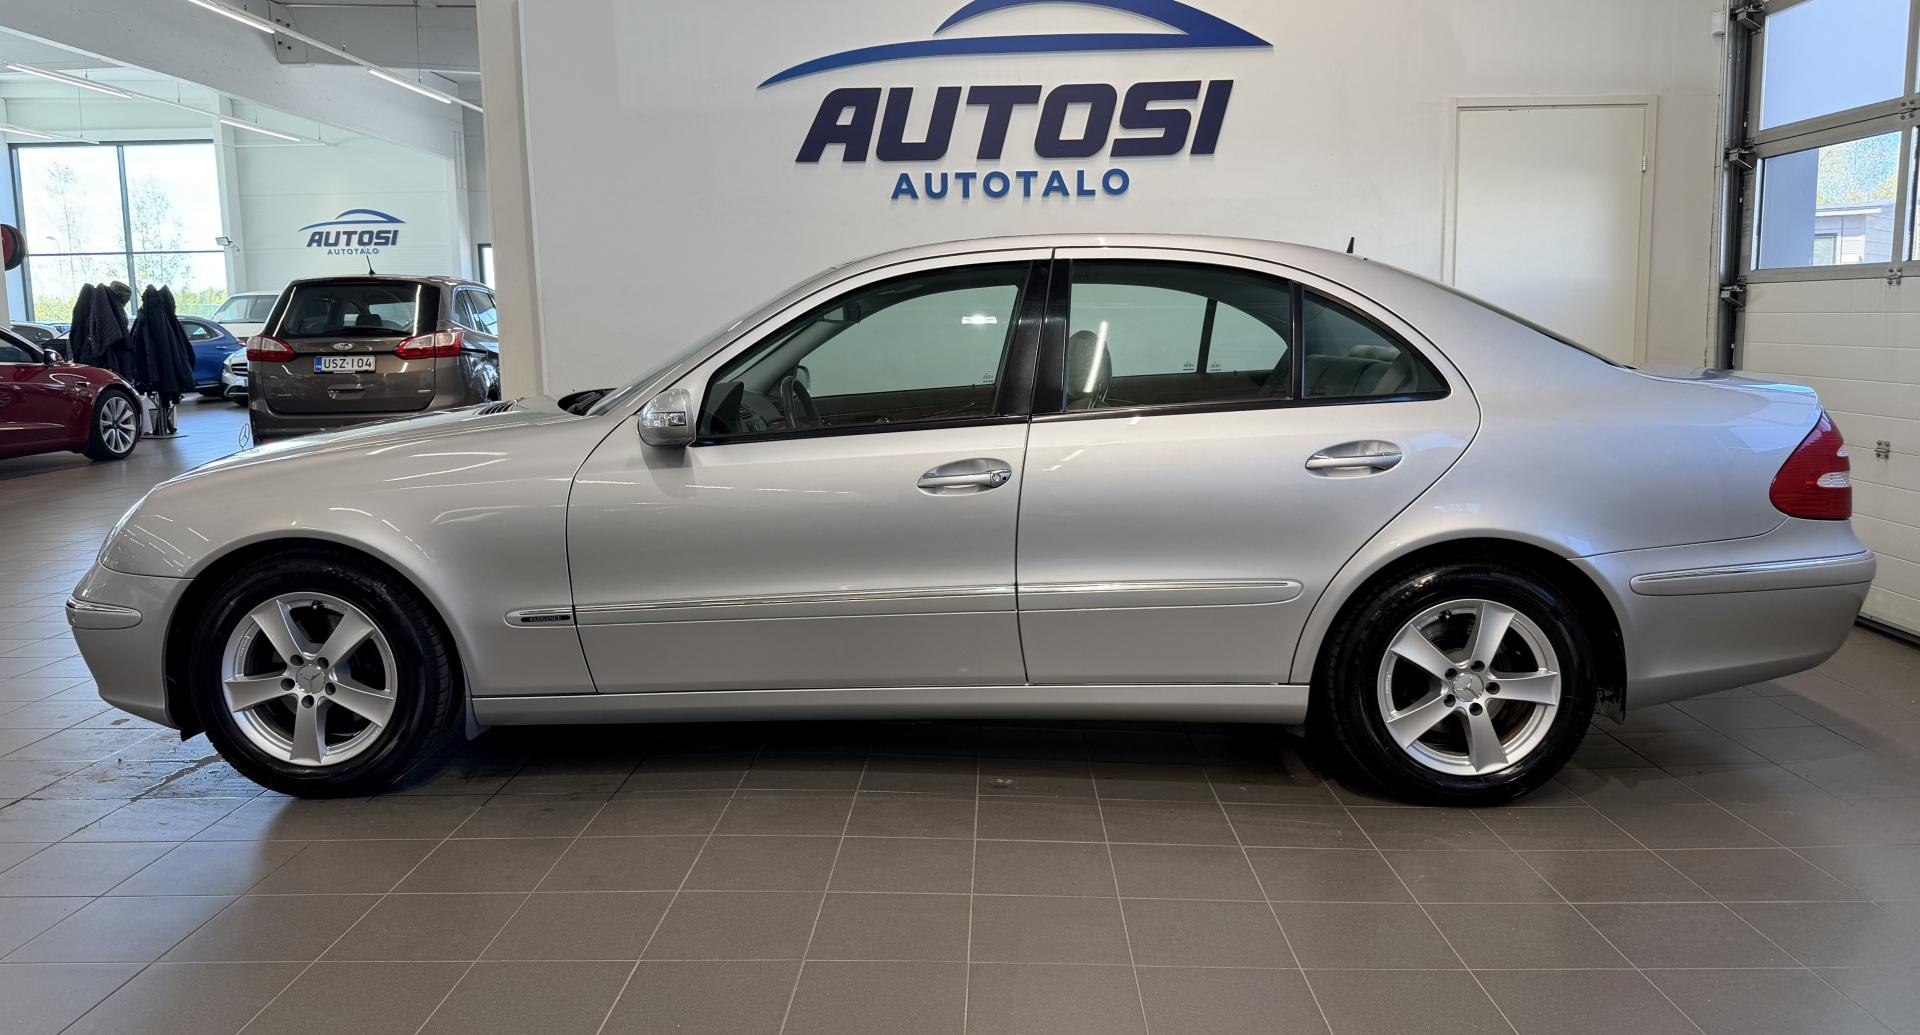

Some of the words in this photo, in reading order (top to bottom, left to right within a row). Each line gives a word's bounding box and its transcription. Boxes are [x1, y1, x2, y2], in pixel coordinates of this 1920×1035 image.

[795, 80, 1234, 162] AUTOSI
[891, 168, 1130, 199] AUTOTALO
[306, 230, 399, 247] AUTOSI
[324, 358, 372, 368] USZ-104
